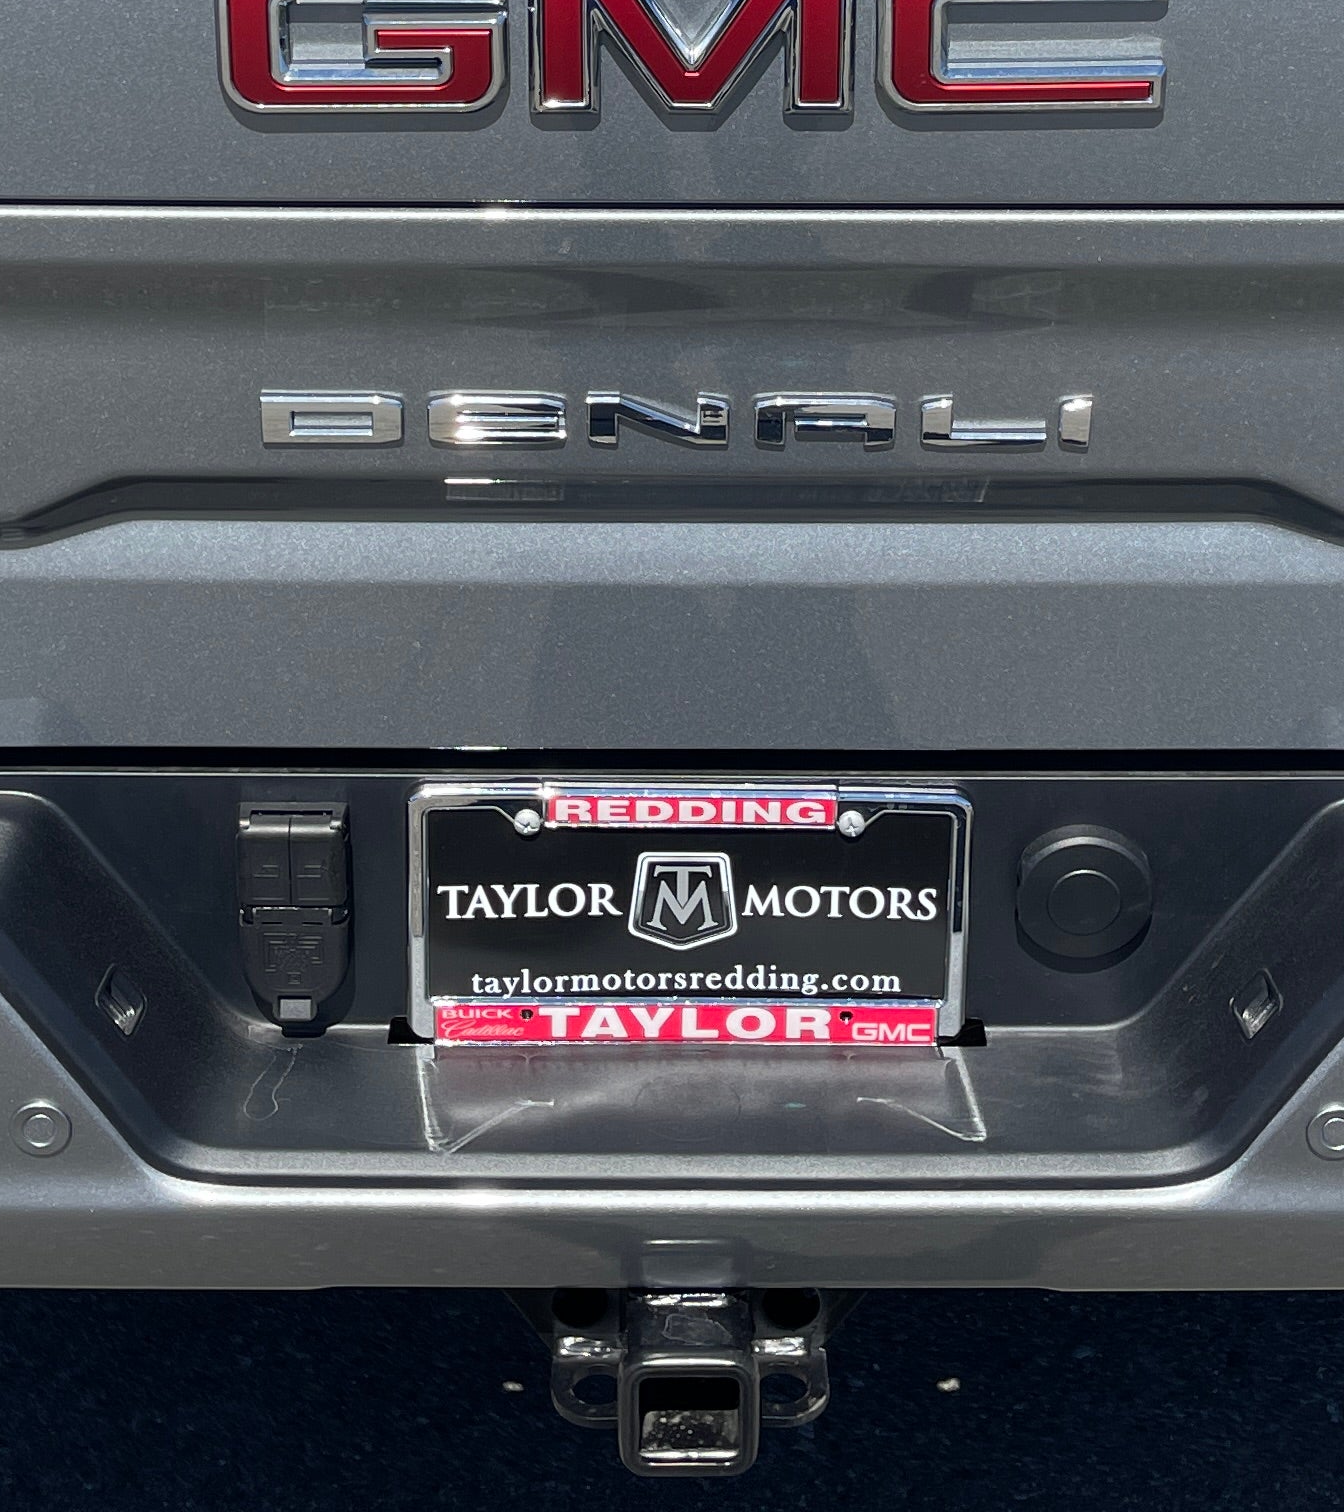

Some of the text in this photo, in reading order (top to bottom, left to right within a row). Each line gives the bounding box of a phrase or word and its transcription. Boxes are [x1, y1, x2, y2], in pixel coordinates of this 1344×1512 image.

[259, 388, 1094, 449] DENALI
[555, 797, 828, 825] REDDING
[436, 882, 939, 922] TAYLOR MOTORS
[471, 965, 902, 1000] taylormotorsredding.com
[440, 1019, 525, 1041] Cadillac
[441, 1008, 512, 1020] BUICK
[538, 1007, 932, 1043] TAYLOR GMC
